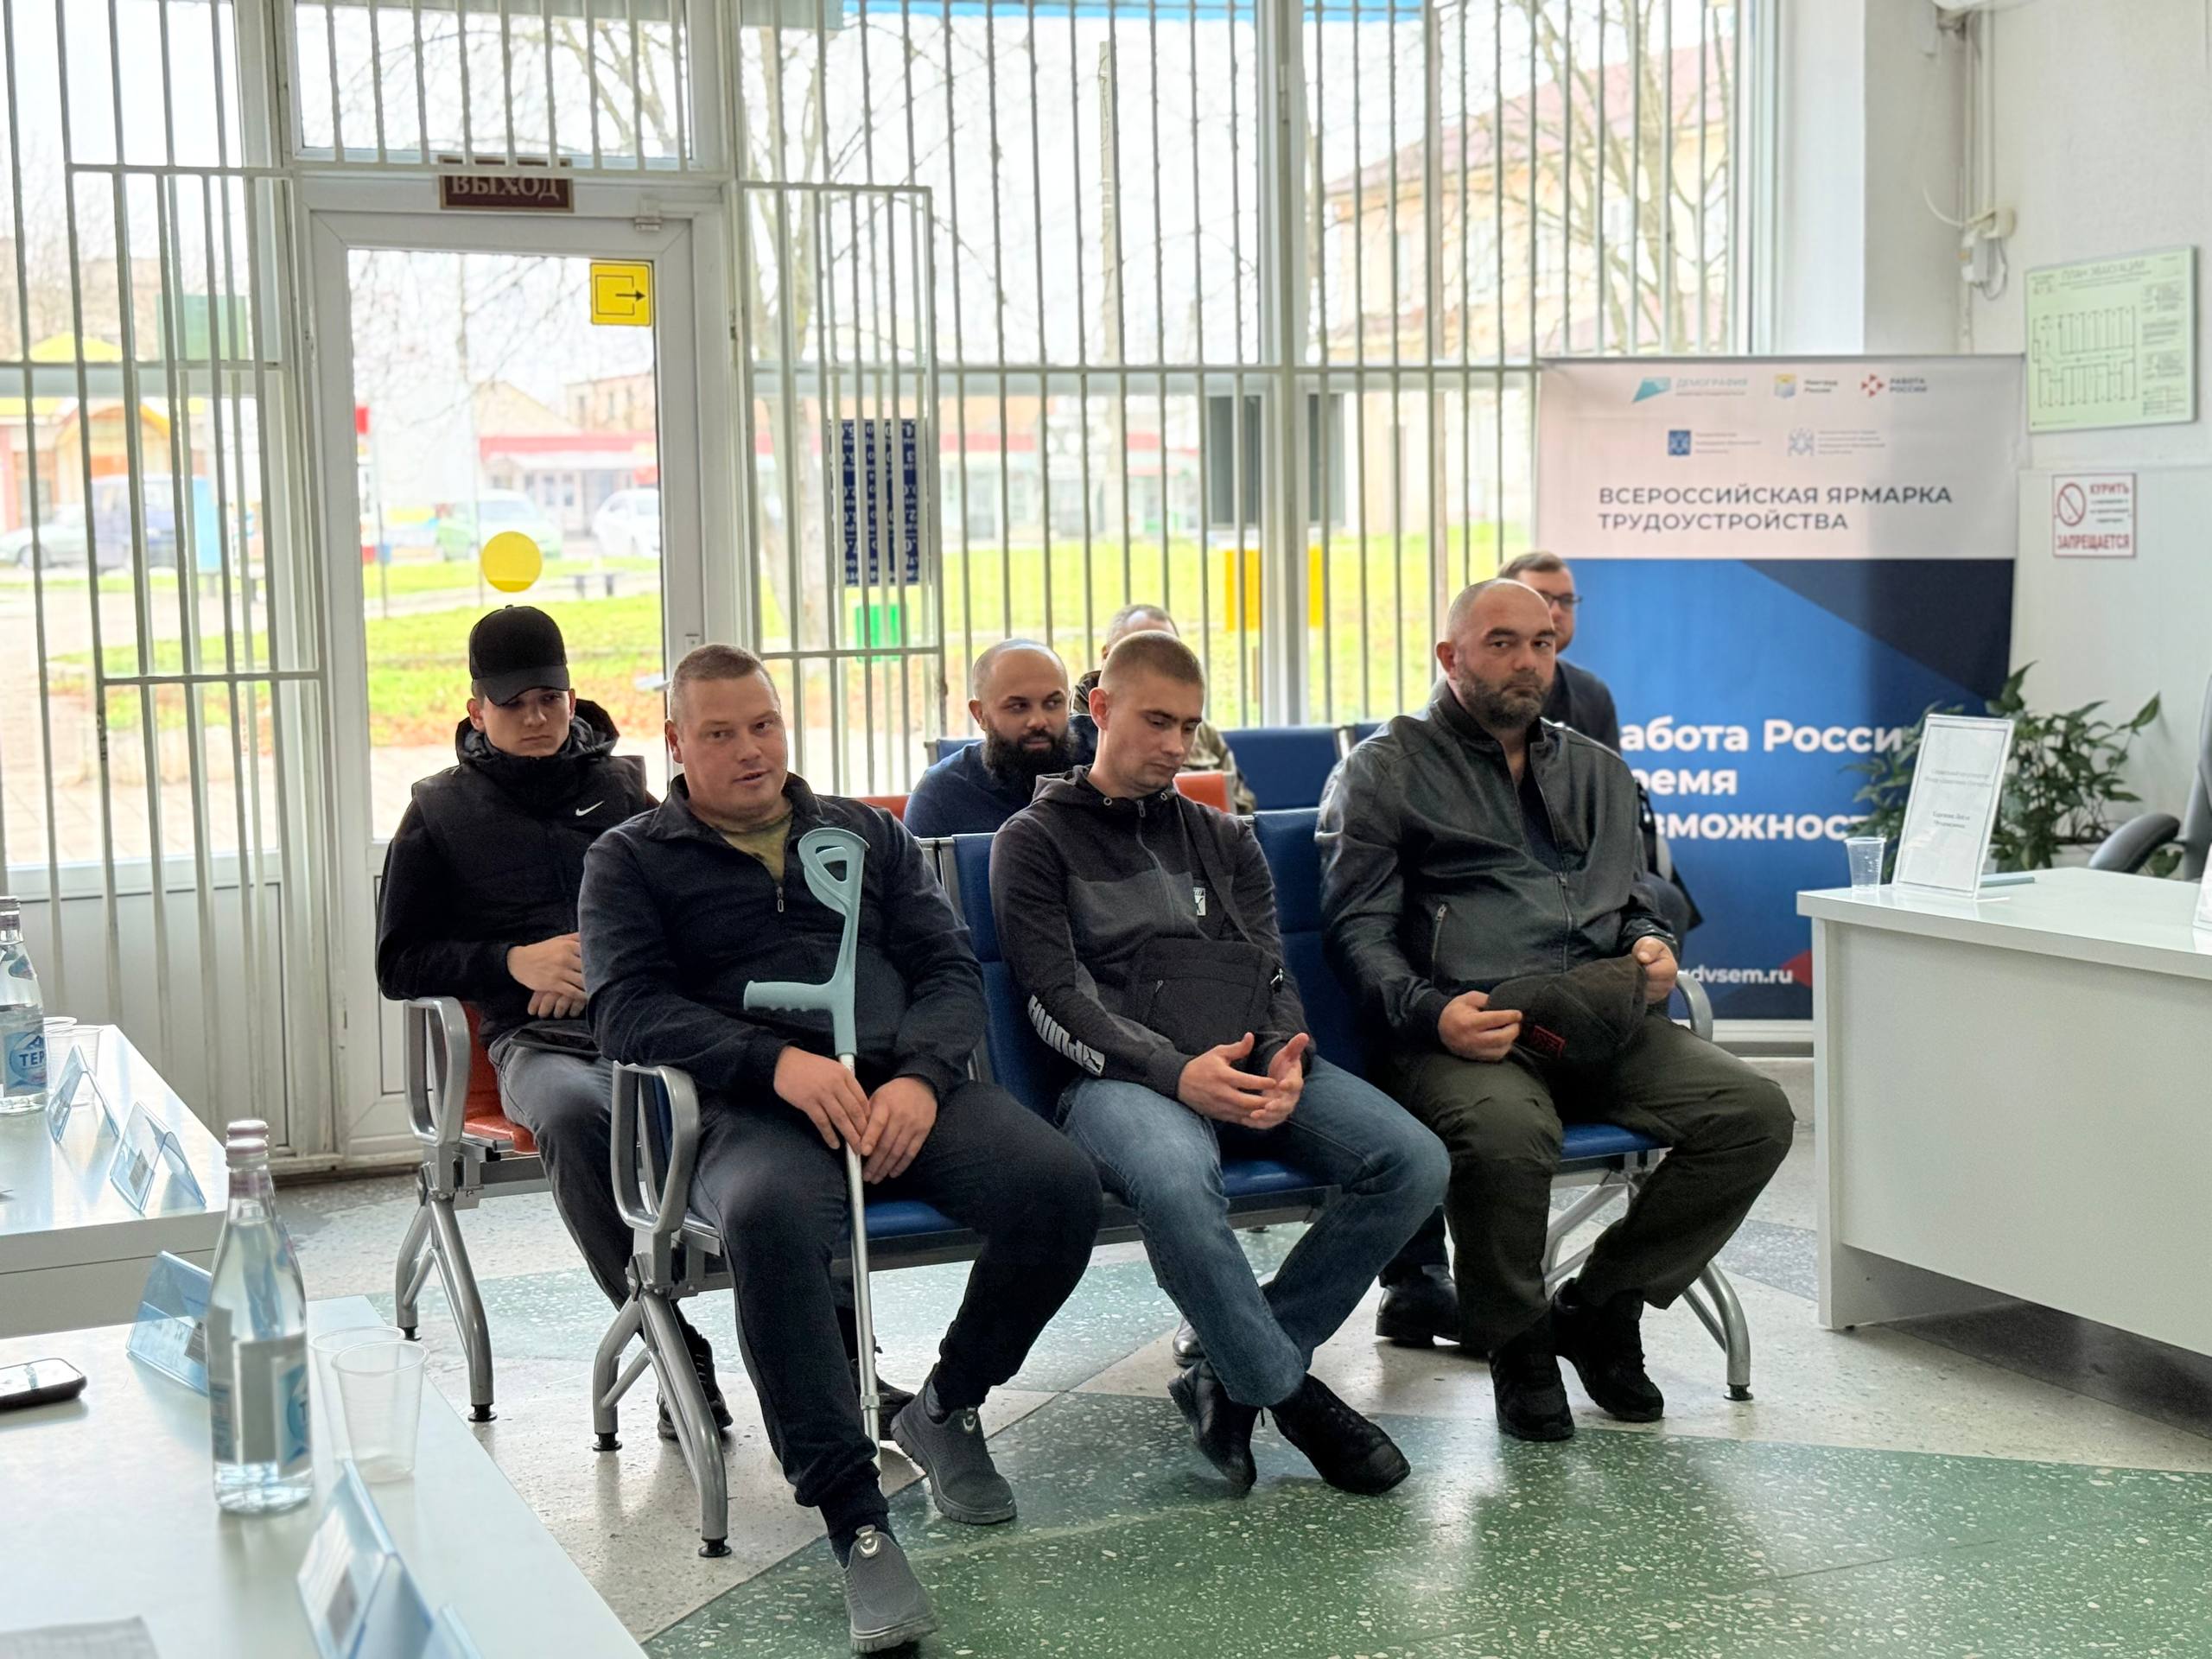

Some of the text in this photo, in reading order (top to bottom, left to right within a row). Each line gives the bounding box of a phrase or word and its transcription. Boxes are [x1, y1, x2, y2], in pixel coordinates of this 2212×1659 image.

[452, 175, 560, 200] ВЫХОД
[1599, 482, 1953, 505] ВСЕРОССИЙСКАЯ ЯРМАРКА
[2089, 483, 2130, 495] КУРИТЬ
[1599, 508, 1848, 532] ТРУДОУСТРОЙСТВА
[2056, 533, 2130, 551] ЗАПРЕЩАЕТСЯ
[1619, 716, 1904, 753] абота Росси
[1630, 767, 1738, 797] емя
[1685, 963, 1794, 984] dvsem.ru
